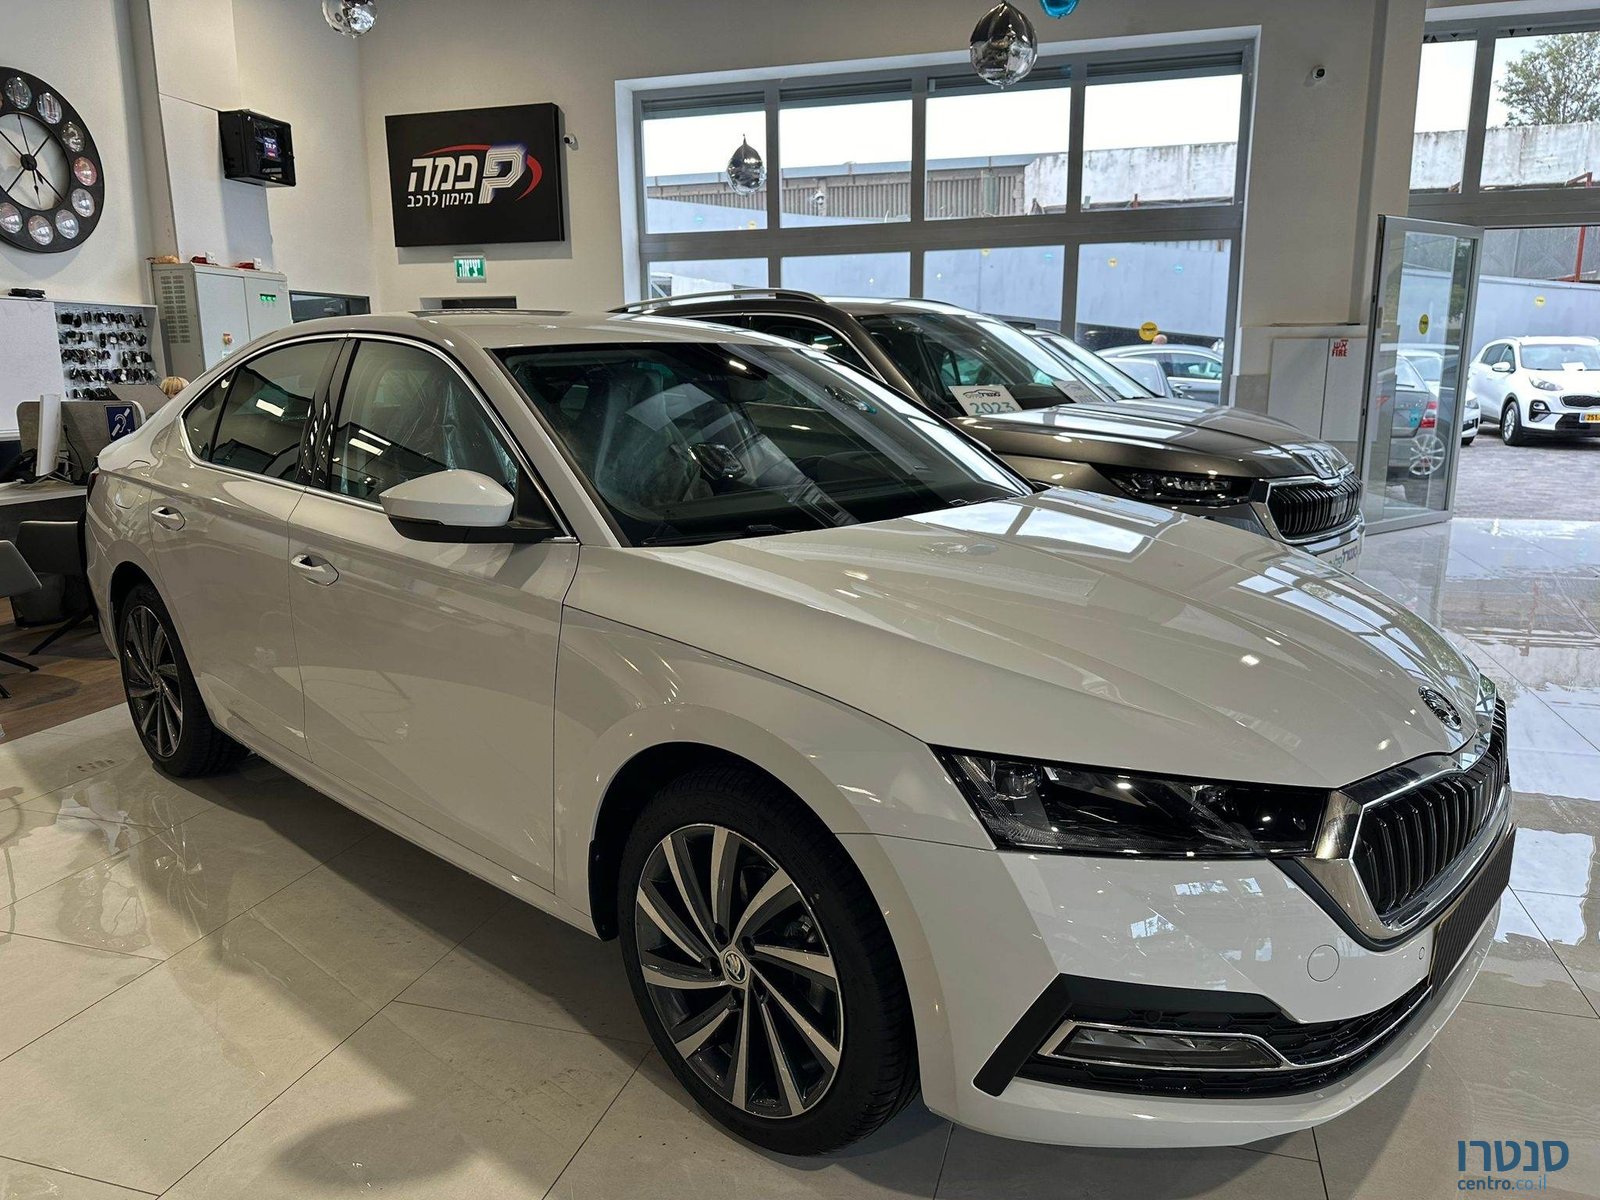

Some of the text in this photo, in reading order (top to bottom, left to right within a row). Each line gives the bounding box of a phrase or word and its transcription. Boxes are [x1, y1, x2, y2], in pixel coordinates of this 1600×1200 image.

[407, 155, 479, 192] פמה
[407, 191, 474, 208] מימון לרכב
[458, 259, 481, 277] יציאה
[1331, 349, 1348, 357] FIRE
[970, 402, 1015, 414] 2023
